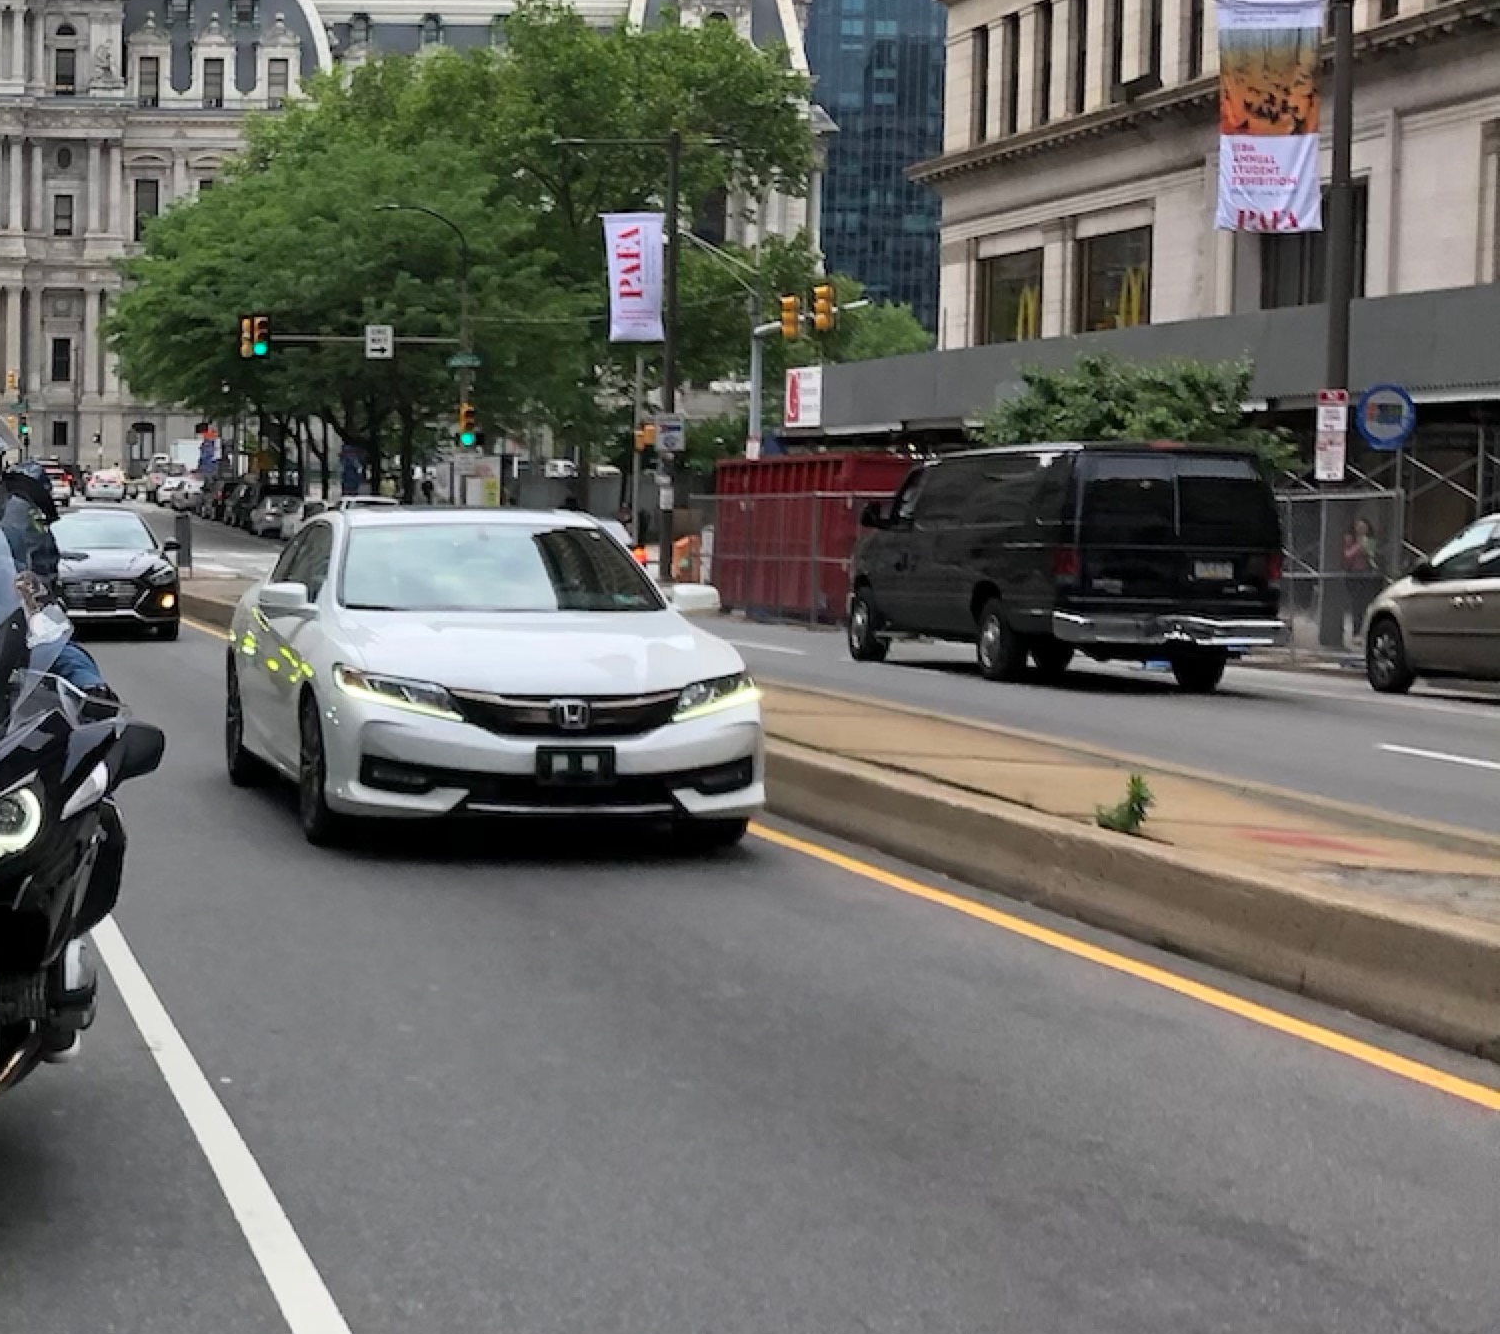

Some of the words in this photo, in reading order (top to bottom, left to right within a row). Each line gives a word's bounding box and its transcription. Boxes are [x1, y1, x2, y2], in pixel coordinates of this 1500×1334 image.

[1232, 154, 1276, 163] ANNUAL
[1231, 166, 1280, 174] STUDENT
[1236, 209, 1299, 230] PAFA
[616, 227, 643, 299] PAFA
